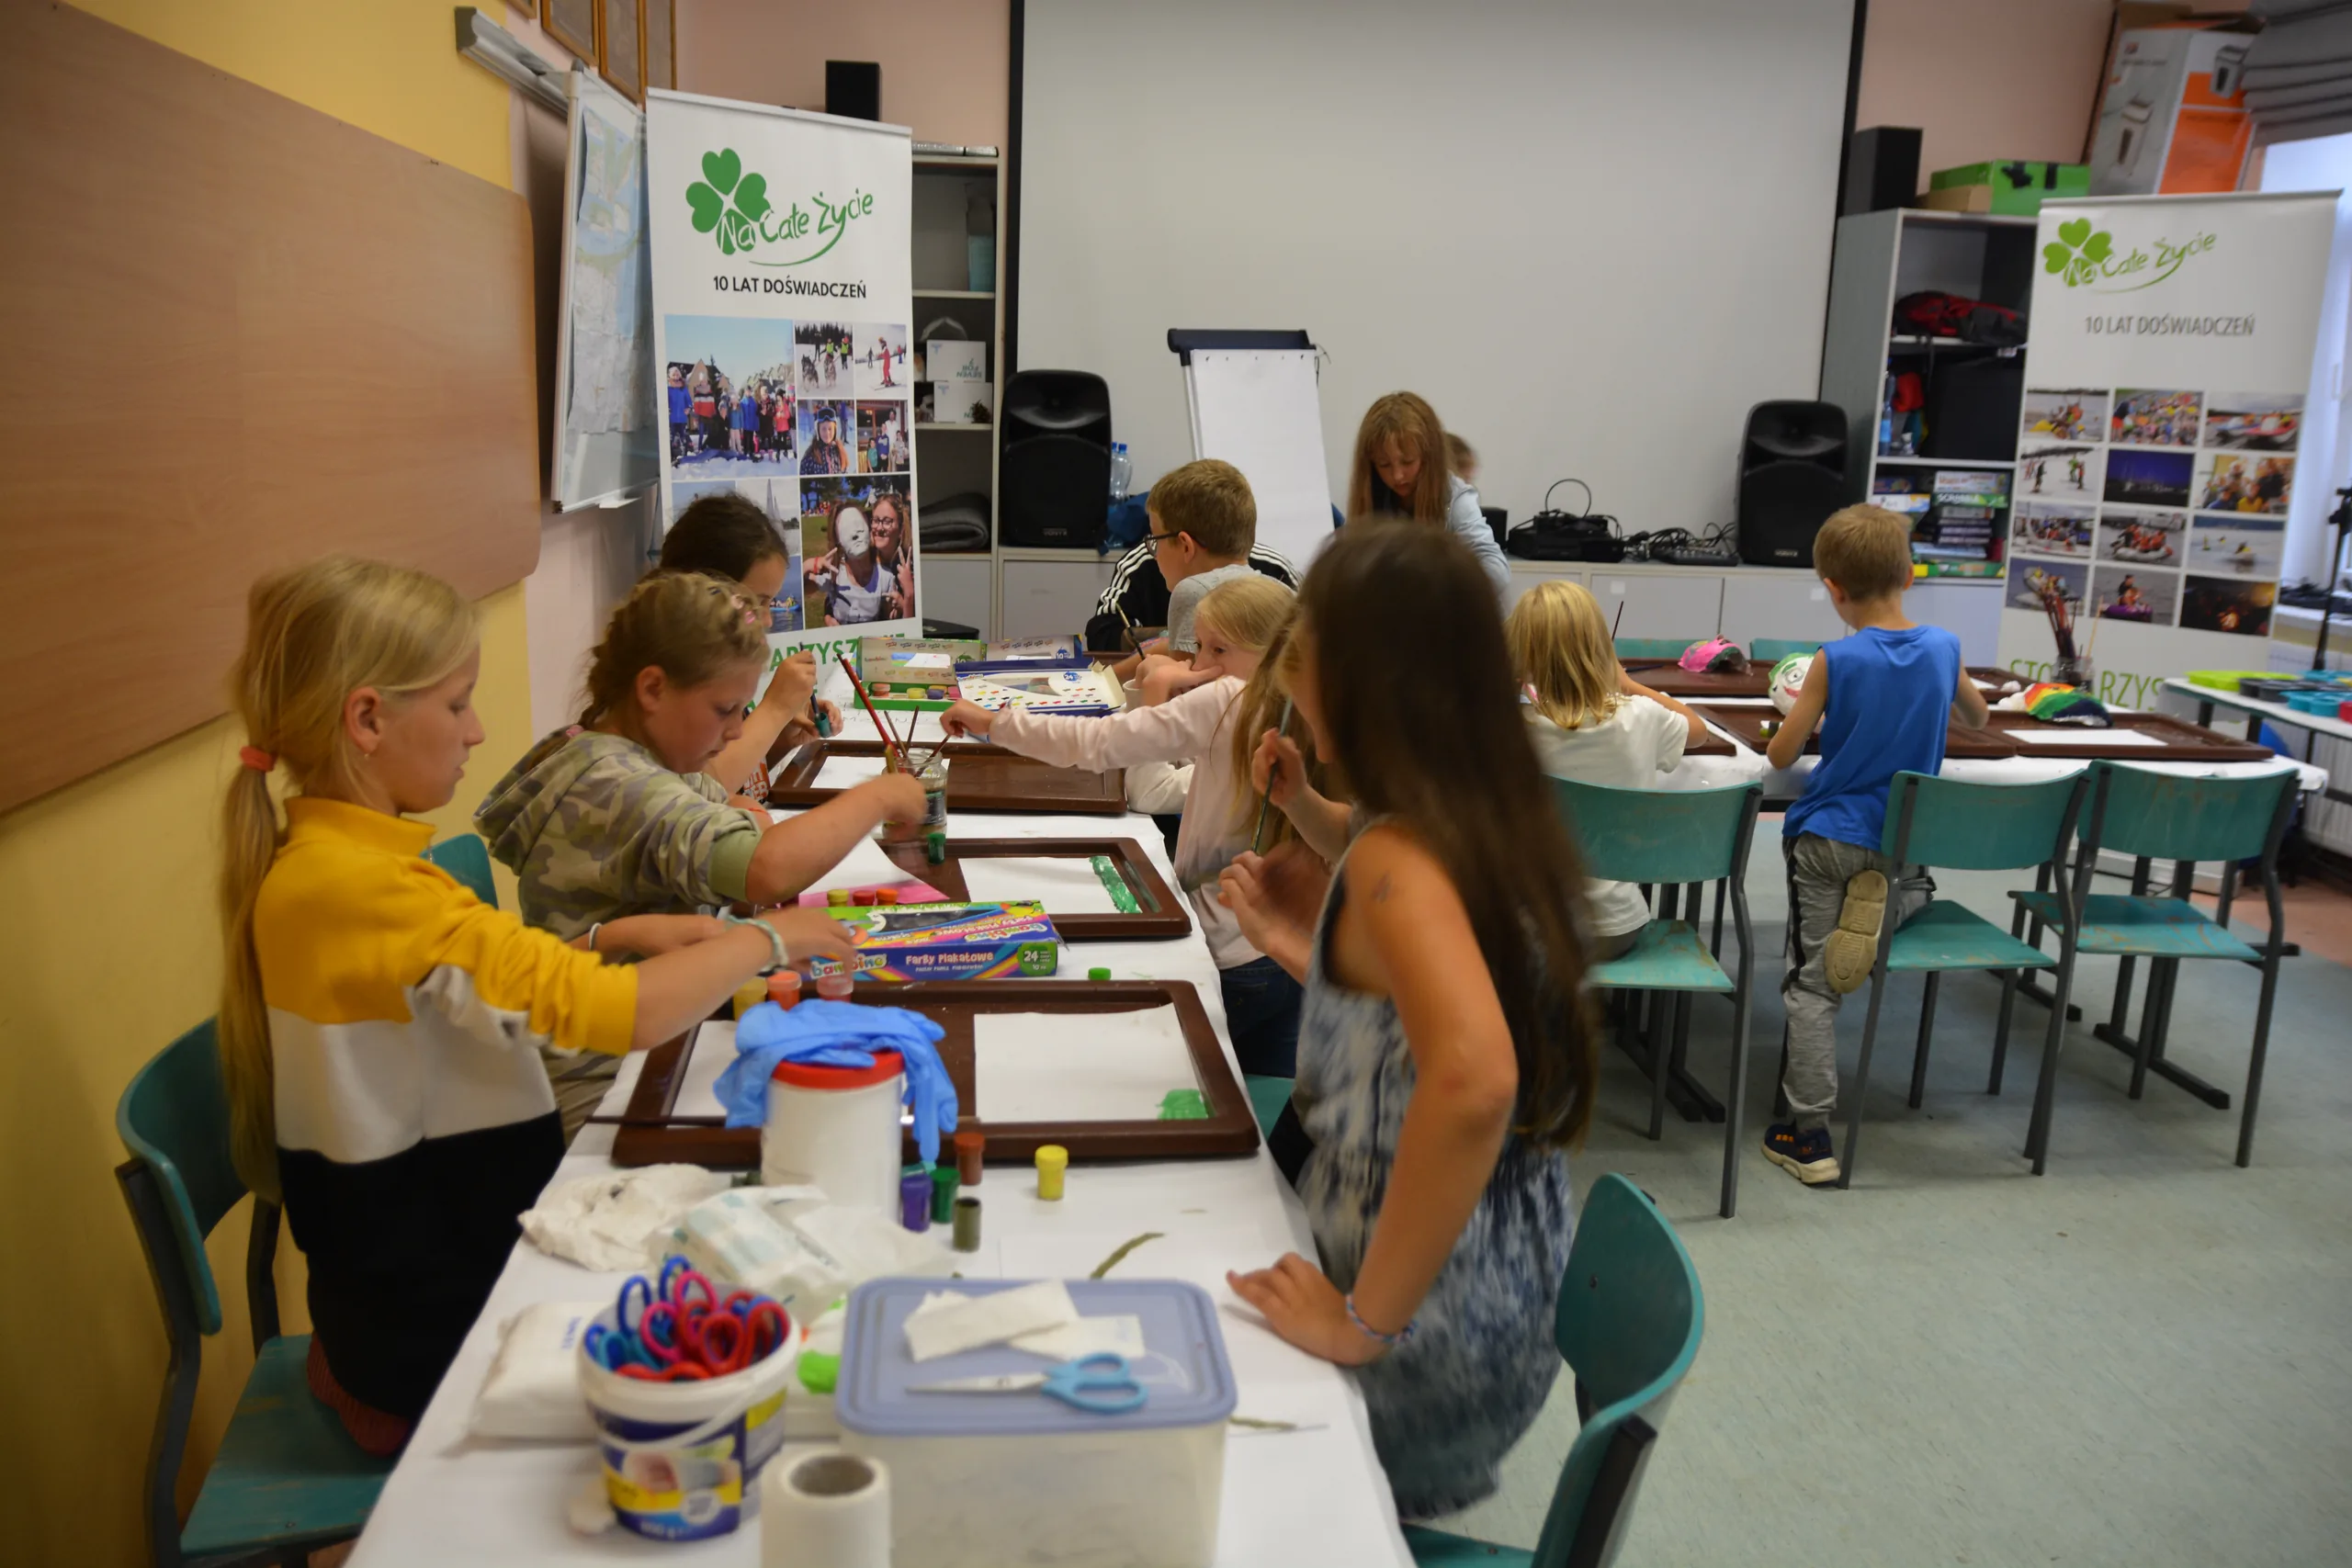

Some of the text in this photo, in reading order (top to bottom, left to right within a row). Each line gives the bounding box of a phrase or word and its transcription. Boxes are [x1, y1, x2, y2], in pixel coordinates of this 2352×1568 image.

[718, 213, 755, 255] Na
[713, 275, 867, 299] 10 LAT DOŚWIADCZEŃ
[2086, 312, 2256, 336] 10 LAT DOŚWIADCZEŃ
[1023, 950, 1039, 963] 24
